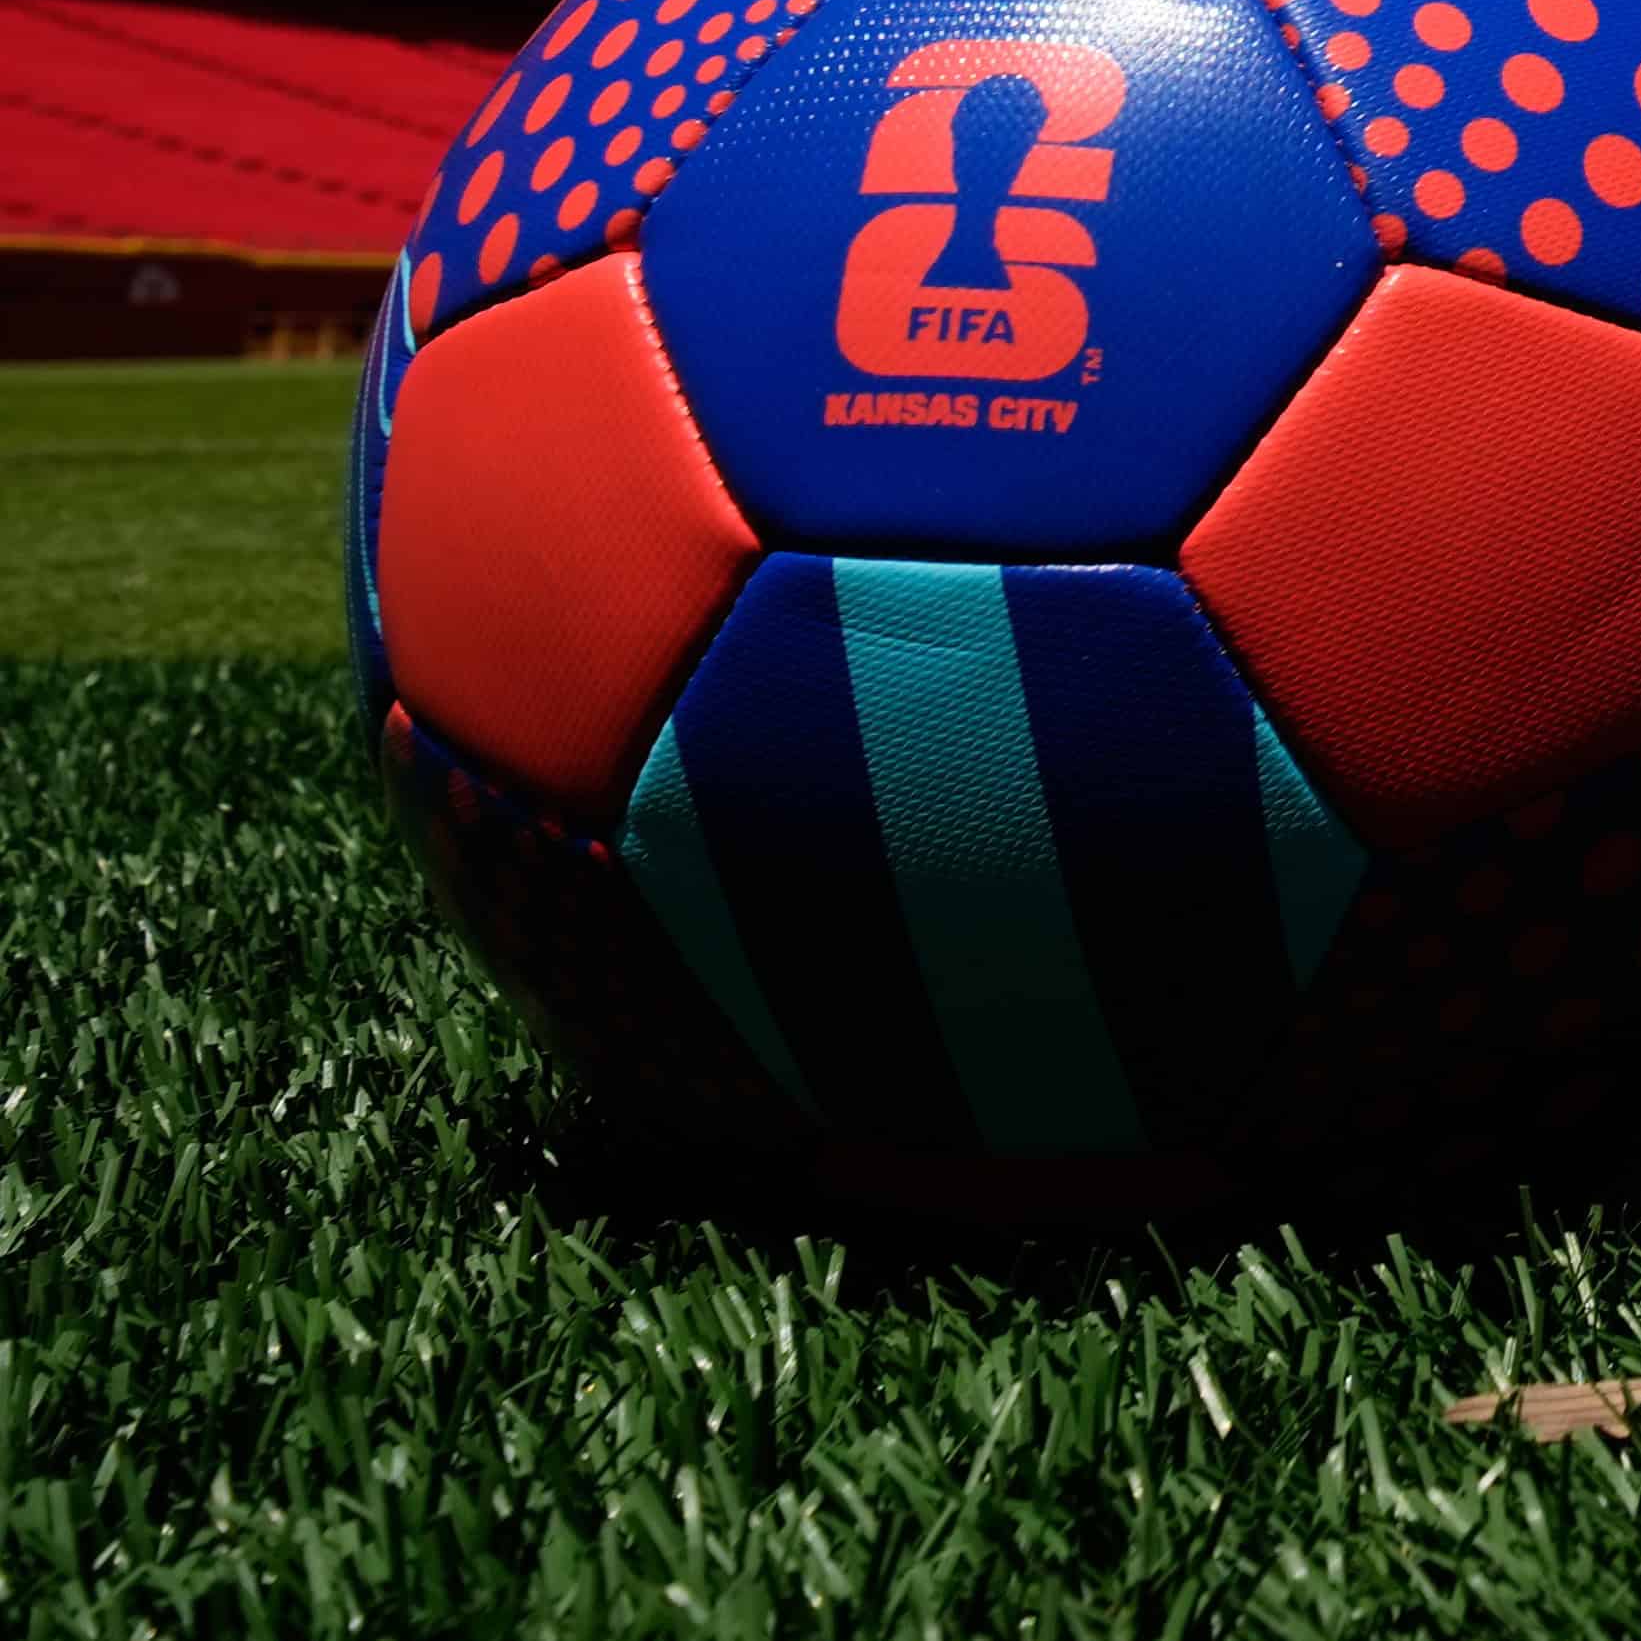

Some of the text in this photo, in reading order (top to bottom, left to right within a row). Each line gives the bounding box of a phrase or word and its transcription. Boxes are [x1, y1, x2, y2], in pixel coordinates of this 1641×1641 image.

[907, 307, 1015, 344] FIFA
[824, 393, 1078, 434] KANSAS CITY
